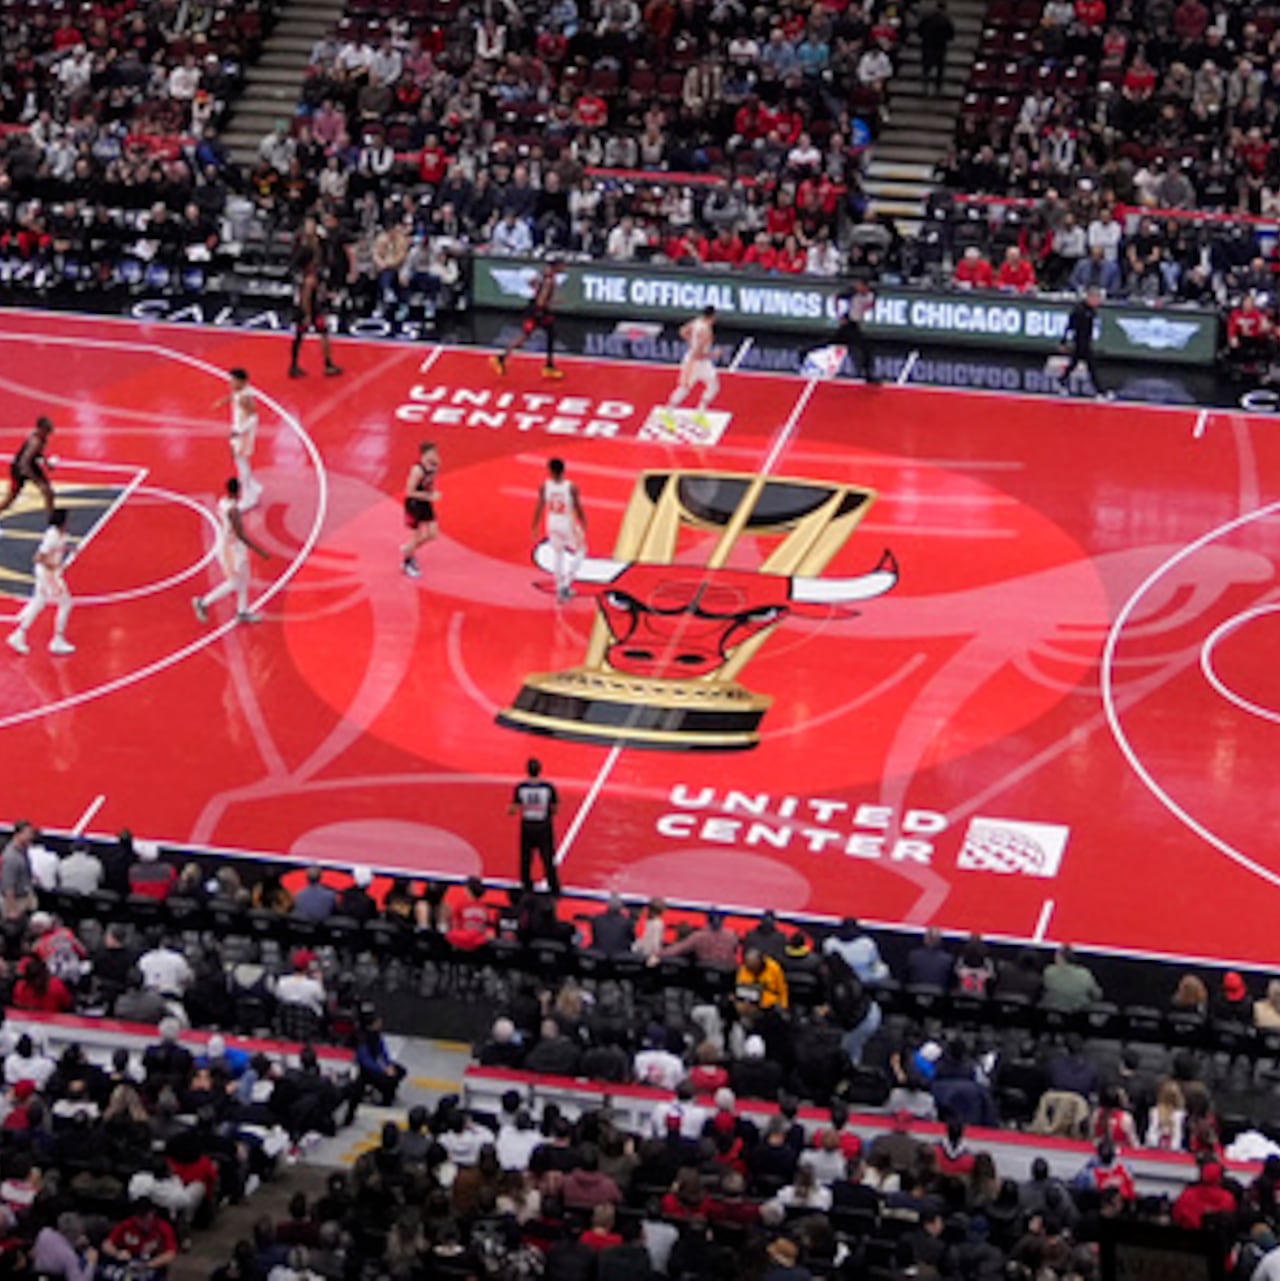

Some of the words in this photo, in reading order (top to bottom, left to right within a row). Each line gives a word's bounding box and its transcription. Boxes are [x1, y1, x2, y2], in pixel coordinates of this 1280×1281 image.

[581, 275, 627, 305] THE
[630, 277, 734, 310] OFFICIAL
[737, 286, 821, 317] WINGS
[911, 303, 1020, 335] CHICAGO
[395, 404, 621, 437] CENTER
[410, 385, 635, 418] UNITED
[669, 784, 949, 833] UNITED
[656, 814, 936, 865] CENTER
